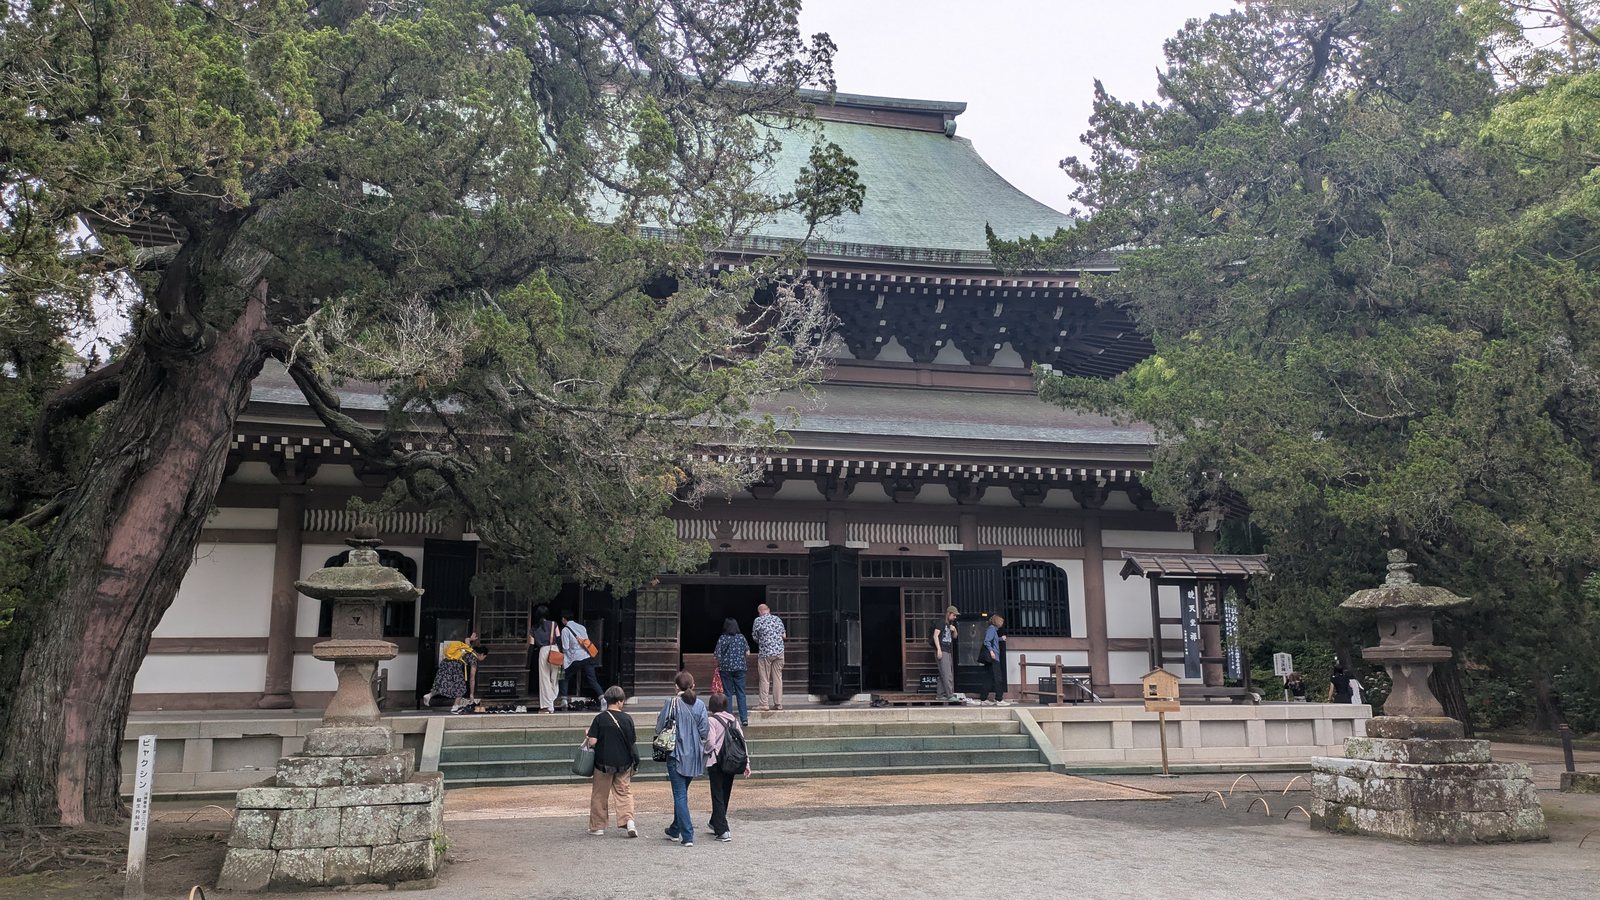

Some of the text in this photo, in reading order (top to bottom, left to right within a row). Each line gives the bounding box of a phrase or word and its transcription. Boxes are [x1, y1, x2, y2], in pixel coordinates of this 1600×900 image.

[139, 738, 151, 789] ビャクシン
